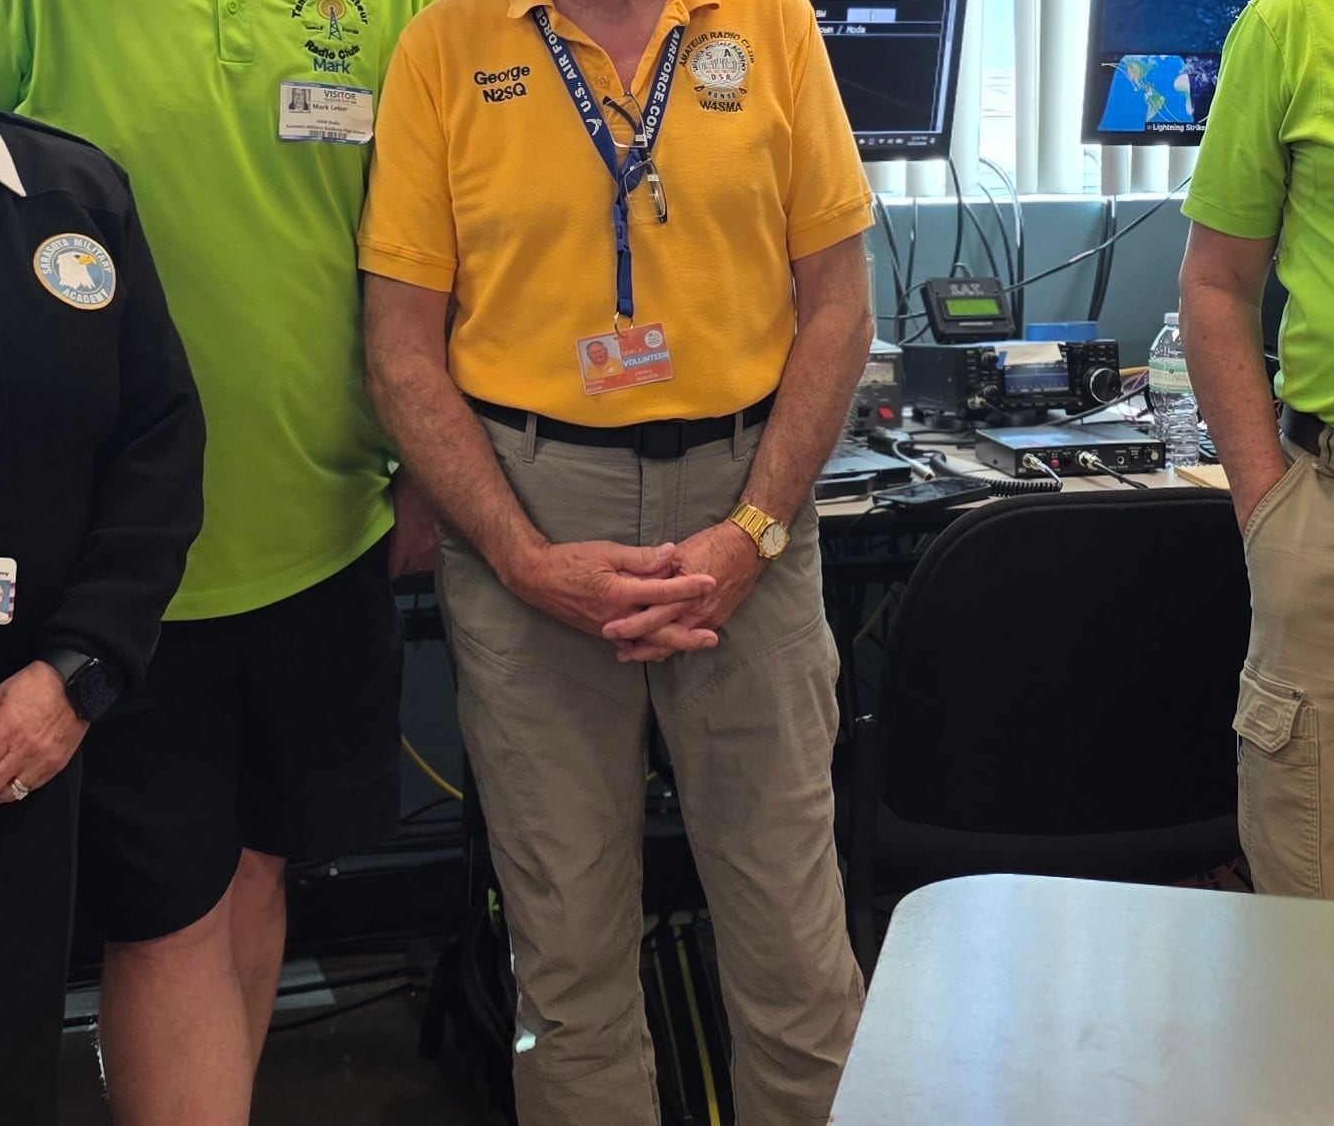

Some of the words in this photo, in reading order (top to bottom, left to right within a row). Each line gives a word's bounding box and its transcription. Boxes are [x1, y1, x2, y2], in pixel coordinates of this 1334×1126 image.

[536, 7, 563, 54] FORCE
[304, 40, 336, 60] Radio
[338, 44, 361, 61] Club
[679, 33, 709, 68] AMATEUR
[710, 31, 741, 41] RADIO
[313, 58, 351, 74] Mark
[474, 65, 530, 85] George
[558, 54, 578, 80] AIR
[482, 82, 528, 103] N2SQ
[645, 28, 680, 140] AIRFORCE.COM
[323, 89, 357, 101] VISITOR
[312, 103, 329, 111] Mark
[699, 100, 743, 113] W4SMA
[1152, 123, 1184, 132] Lightning
[40, 238, 70, 275] SARASOTA
[73, 237, 113, 273] MILITARY
[62, 288, 110, 304] ACADEMY
[622, 351, 669, 368] VOLUNTEER
